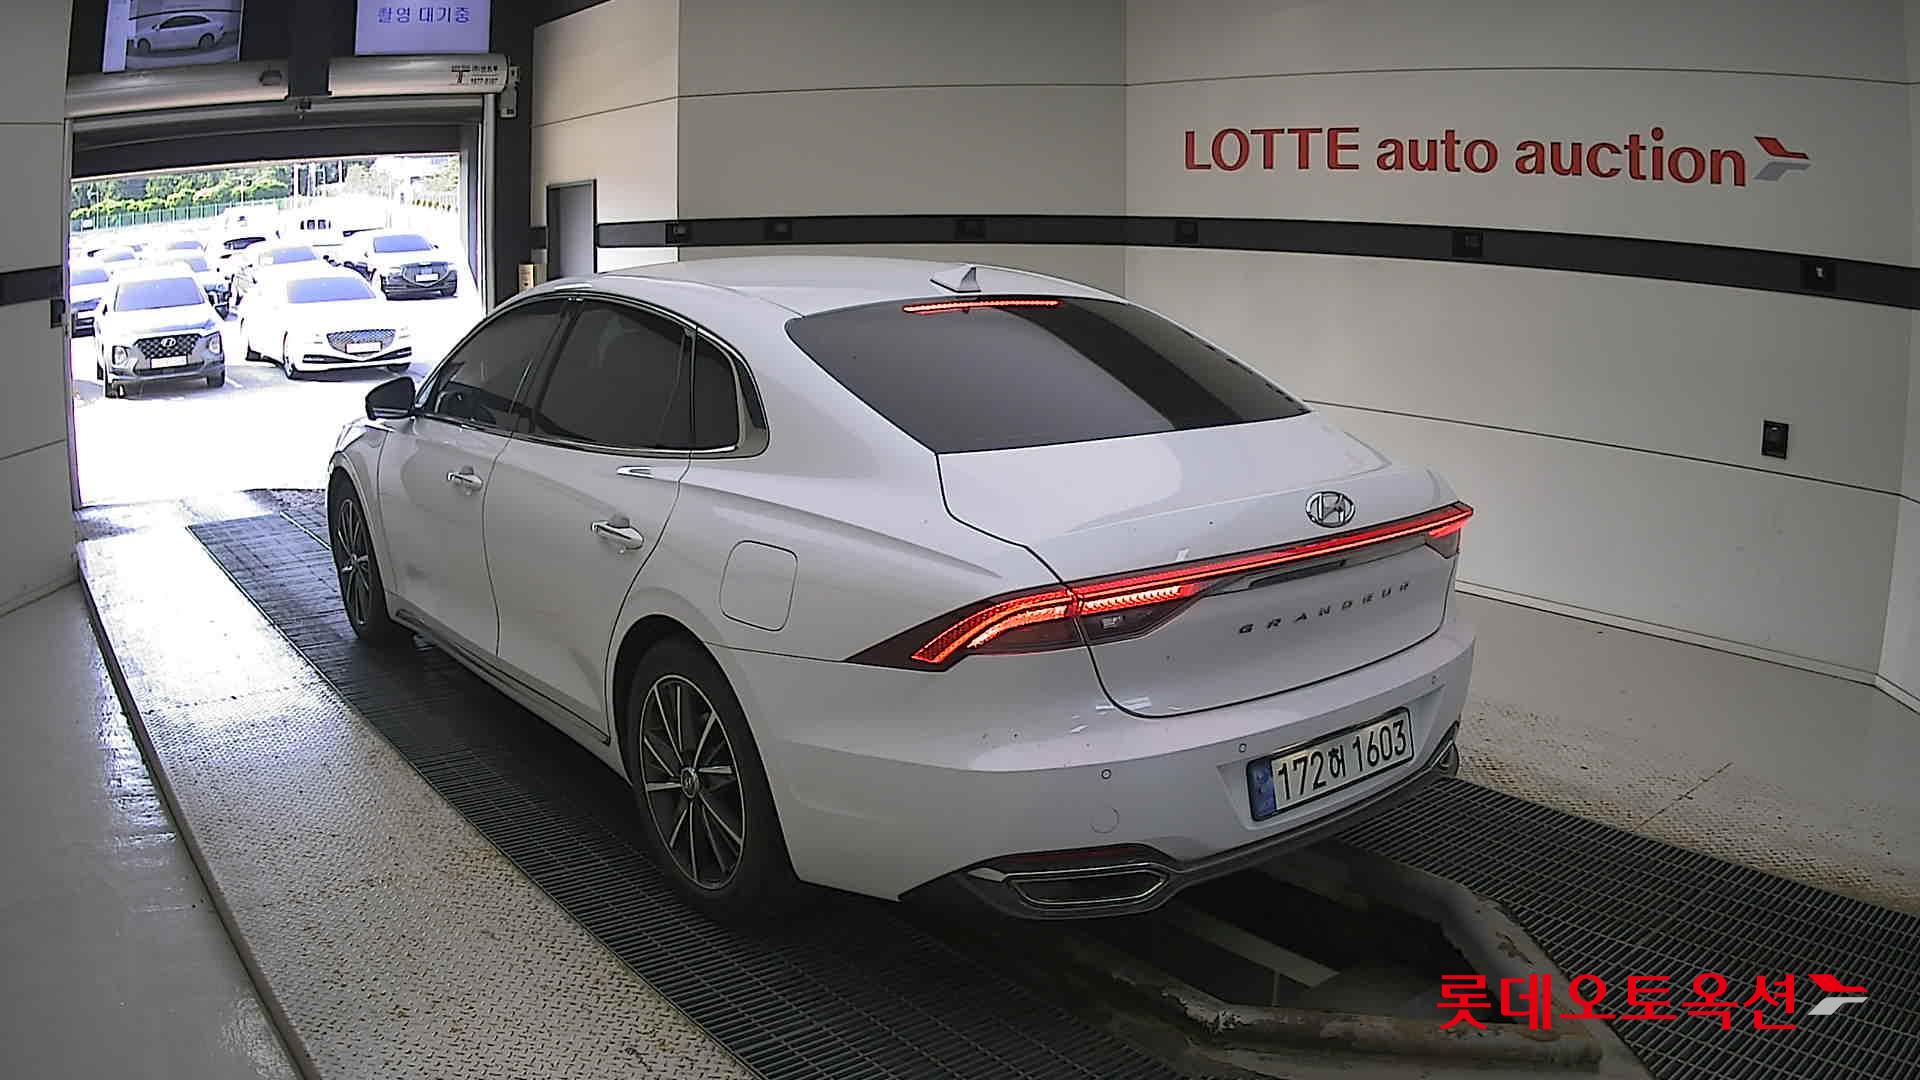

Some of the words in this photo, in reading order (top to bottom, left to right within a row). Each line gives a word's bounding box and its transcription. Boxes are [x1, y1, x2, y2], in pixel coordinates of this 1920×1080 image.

[419, 7, 471, 24] 대기중
[1185, 127, 1360, 171] LOTTE
[1376, 128, 1499, 173] auto
[1515, 127, 1746, 187] auction
[1238, 582, 1410, 634] GRANDEUR
[1352, 719, 1407, 773] 1603
